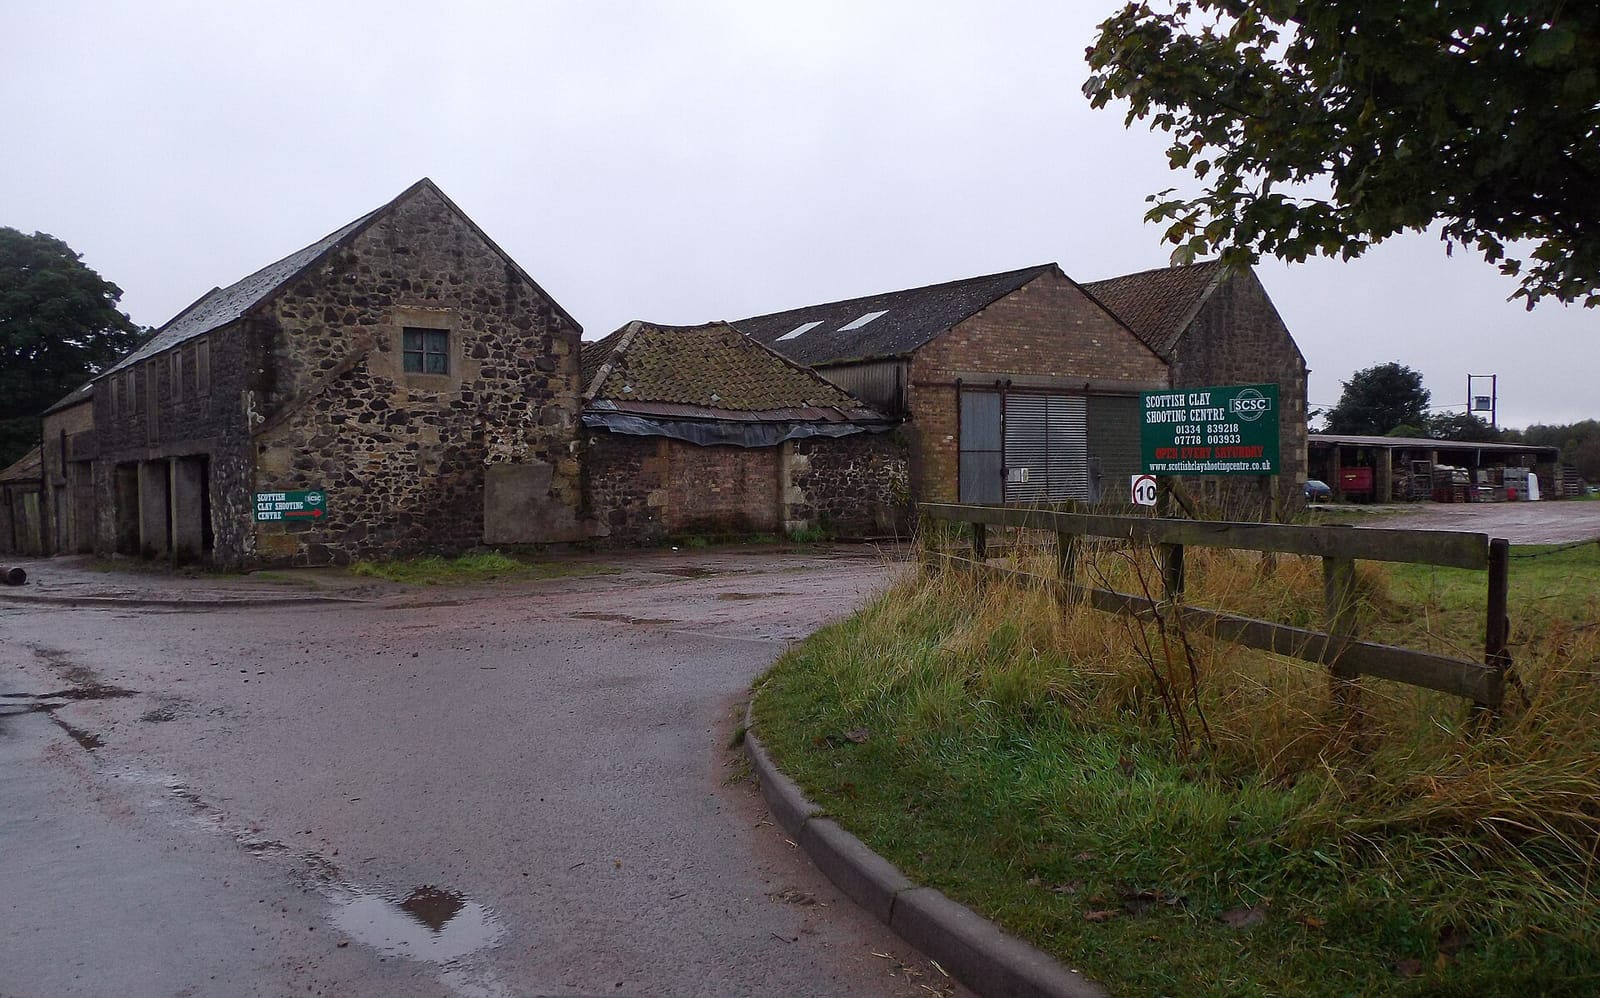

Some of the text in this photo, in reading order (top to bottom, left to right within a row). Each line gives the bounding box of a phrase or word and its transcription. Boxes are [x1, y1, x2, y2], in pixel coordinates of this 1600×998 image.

[1145, 393, 1211, 408] SCOTTISH CLAY
[1235, 400, 1266, 410] SCSC
[1146, 408, 1225, 423] SHOOTING CENTRE
[1176, 424, 1239, 434] 01334 839218
[1174, 435, 1241, 445] 07778 003933
[1155, 447, 1263, 459] OPEN EVERY SATURDAY
[1149, 461, 1271, 472] www.scottishclayshootingcentre.co.uk
[1136, 485, 1156, 501] 10
[275, 502, 303, 510] SHOOTING
